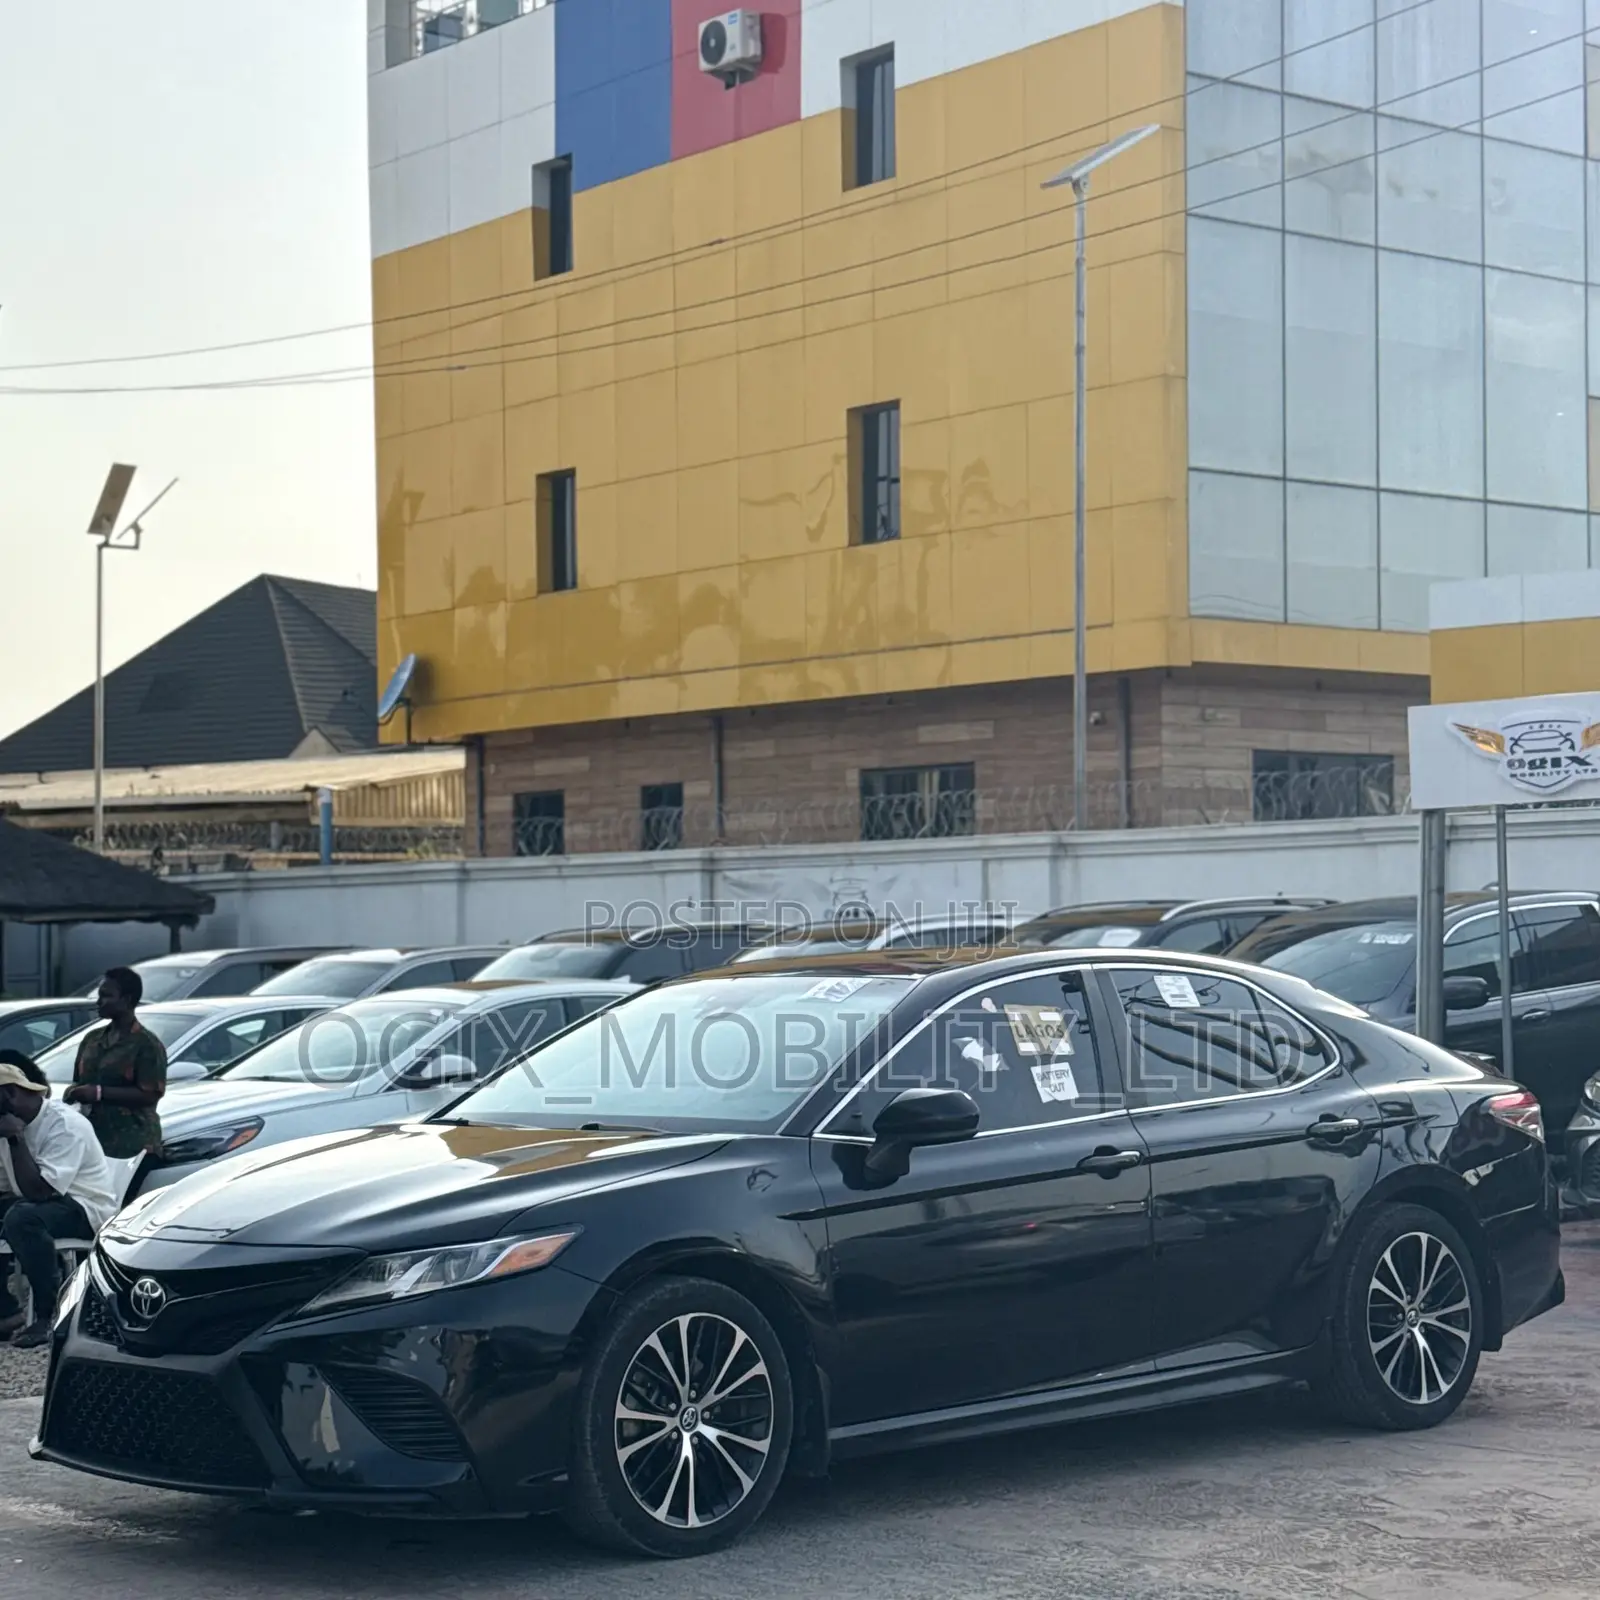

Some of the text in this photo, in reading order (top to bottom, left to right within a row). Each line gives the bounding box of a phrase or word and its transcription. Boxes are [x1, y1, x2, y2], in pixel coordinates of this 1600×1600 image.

[1509, 769, 1571, 778] MOBILITY
[1014, 1023, 1065, 1040] LAGOS
[1035, 1068, 1071, 1082] BATTERY
[1048, 1082, 1066, 1093] OUT
